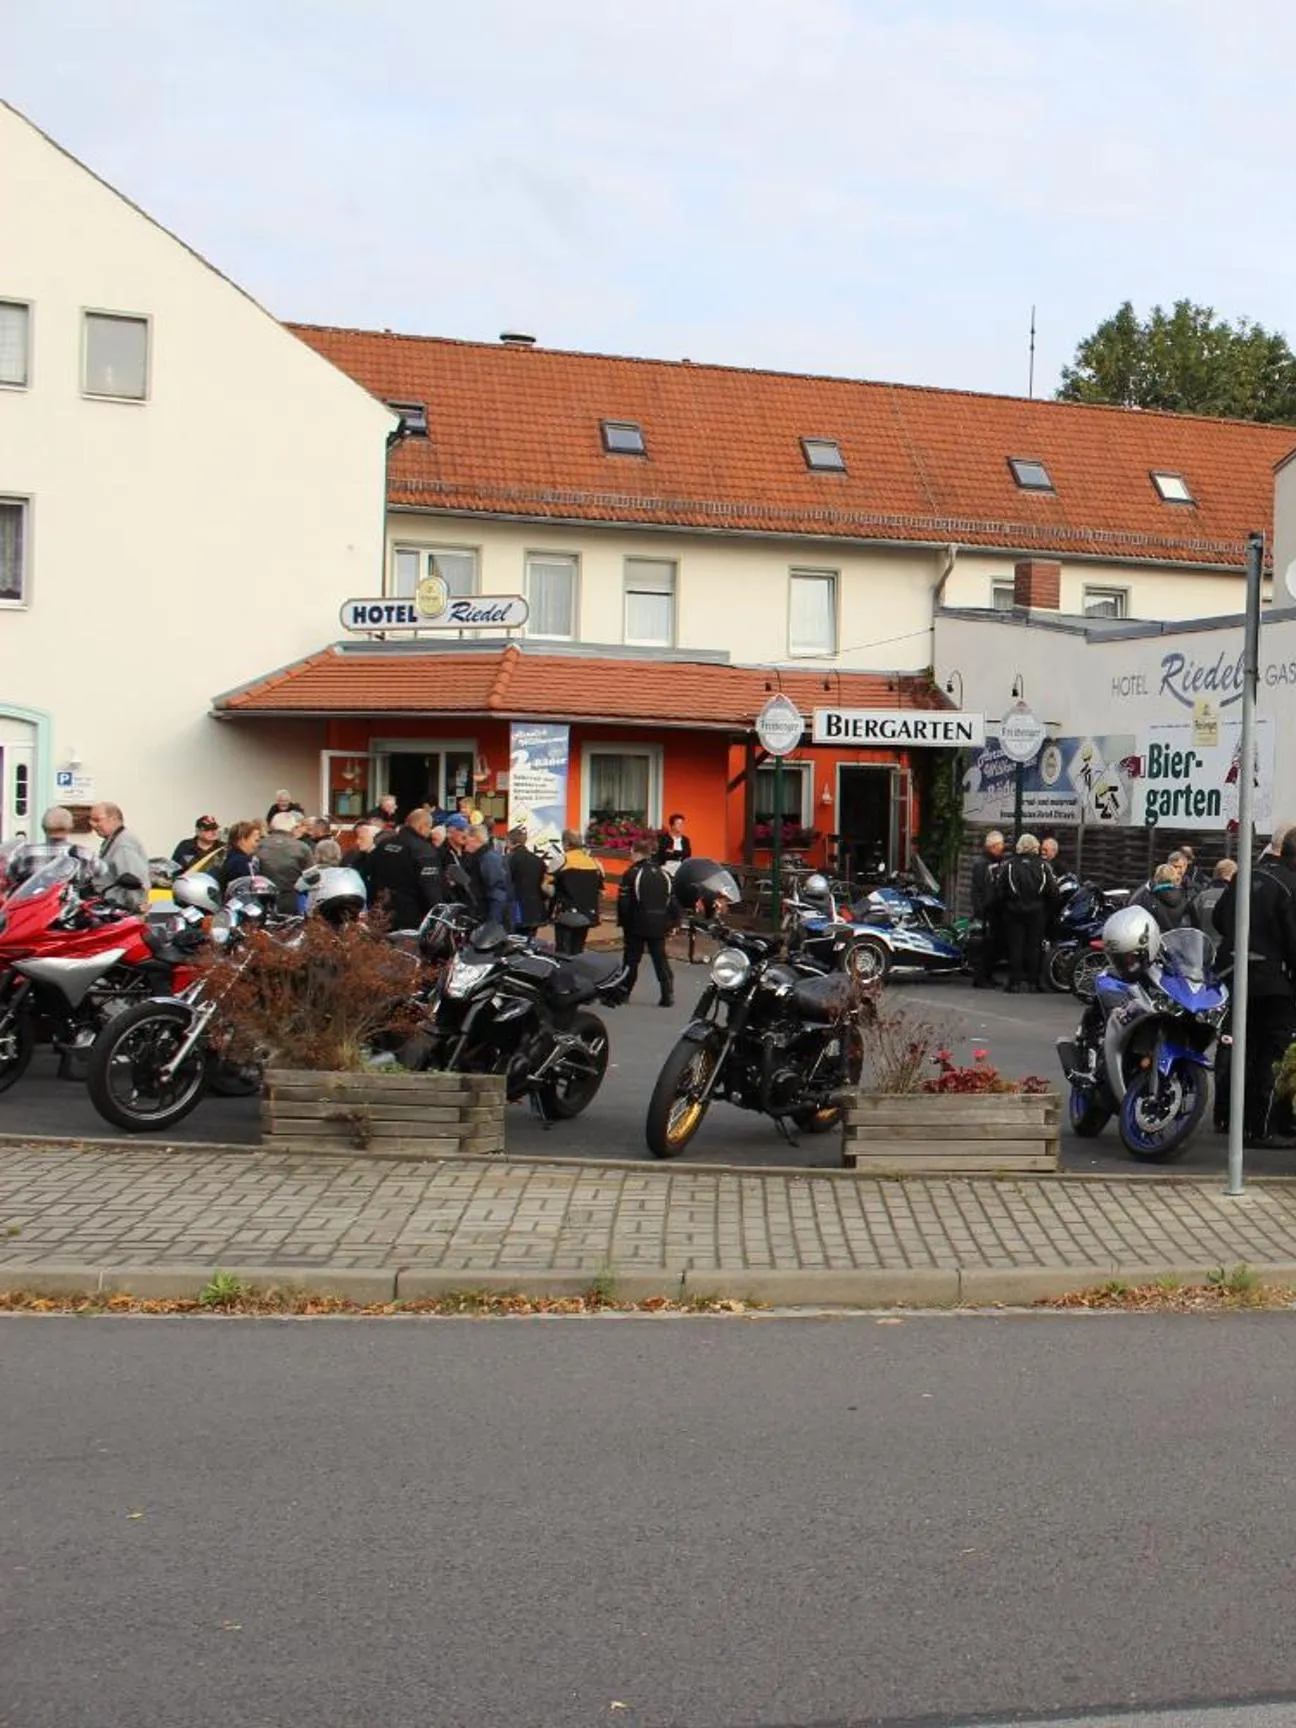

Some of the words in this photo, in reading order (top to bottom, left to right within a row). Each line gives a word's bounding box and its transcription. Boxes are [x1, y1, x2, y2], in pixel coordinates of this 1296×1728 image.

[352, 605, 418, 624] HOTEL
[448, 600, 513, 623] Riedel
[1111, 676, 1149, 697] HOTEL
[1159, 651, 1246, 708] Riedel
[825, 714, 973, 741] BIERGARTEN
[1147, 743, 1204, 779] Bier-
[1144, 783, 1221, 827] garten
